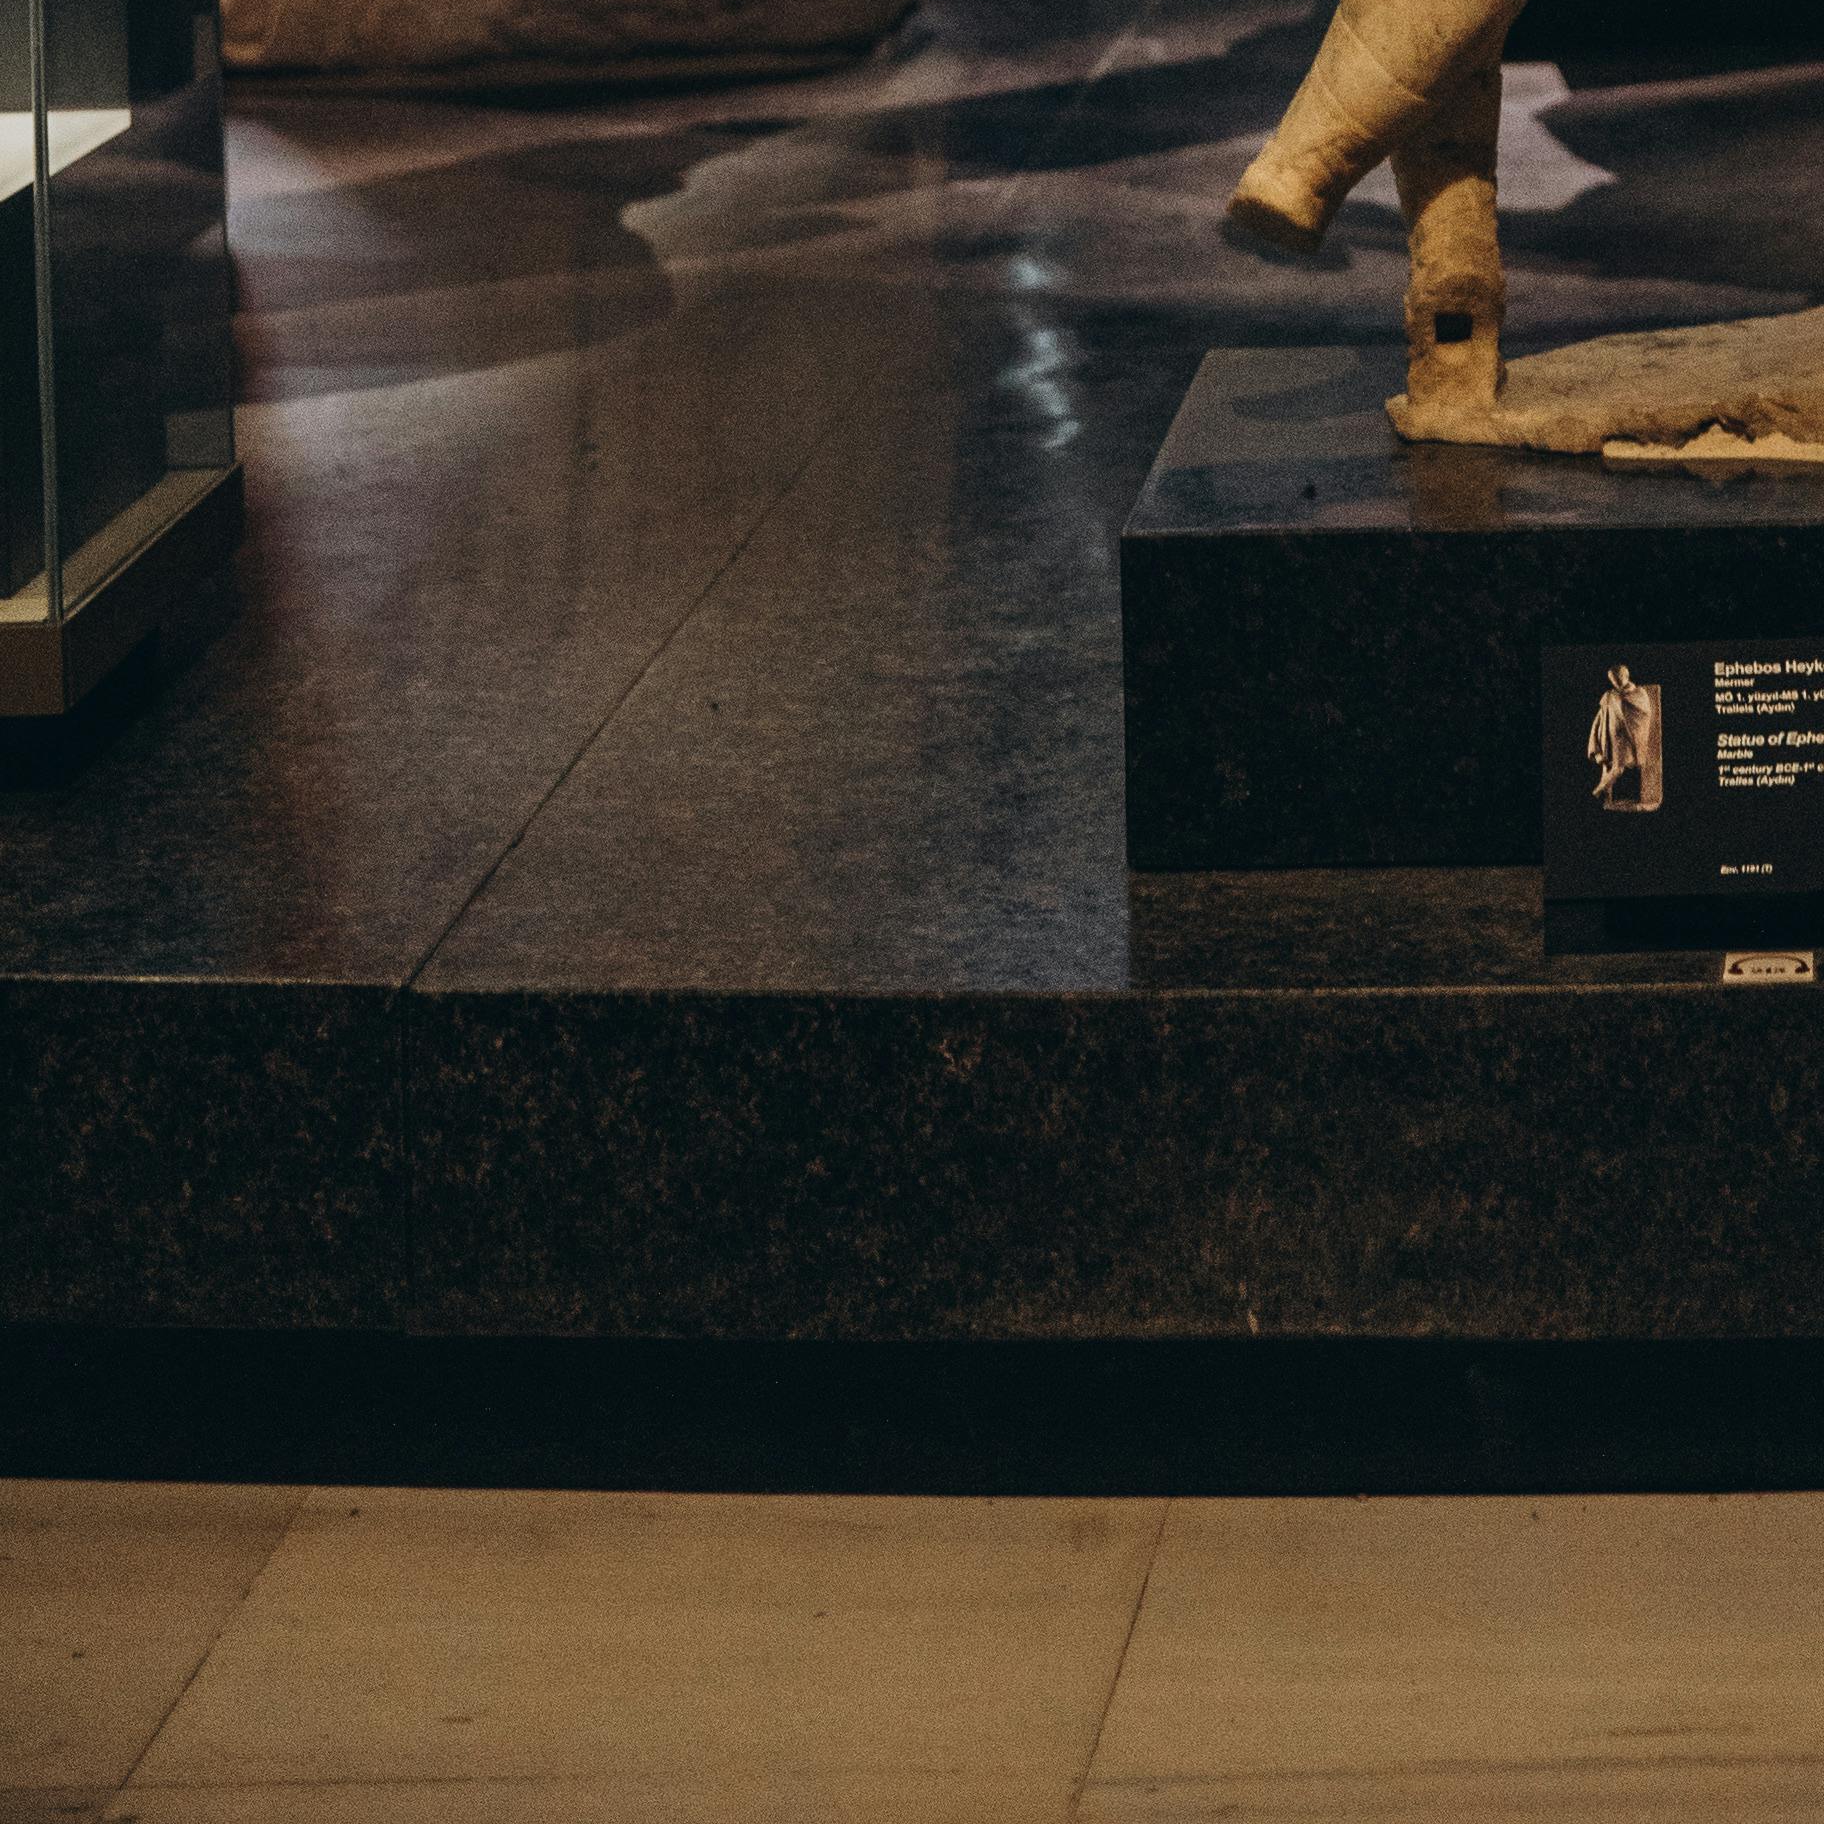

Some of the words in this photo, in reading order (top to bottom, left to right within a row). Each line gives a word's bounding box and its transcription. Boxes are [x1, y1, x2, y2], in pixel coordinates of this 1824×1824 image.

[1714, 661, 1781, 677] Ephebos
[1714, 678, 1755, 688] Mermer
[1717, 733, 1764, 747] Statue
[1767, 731, 1785, 745] of
[1717, 749, 1753, 760] Marble
[1732, 763, 1773, 776] century
